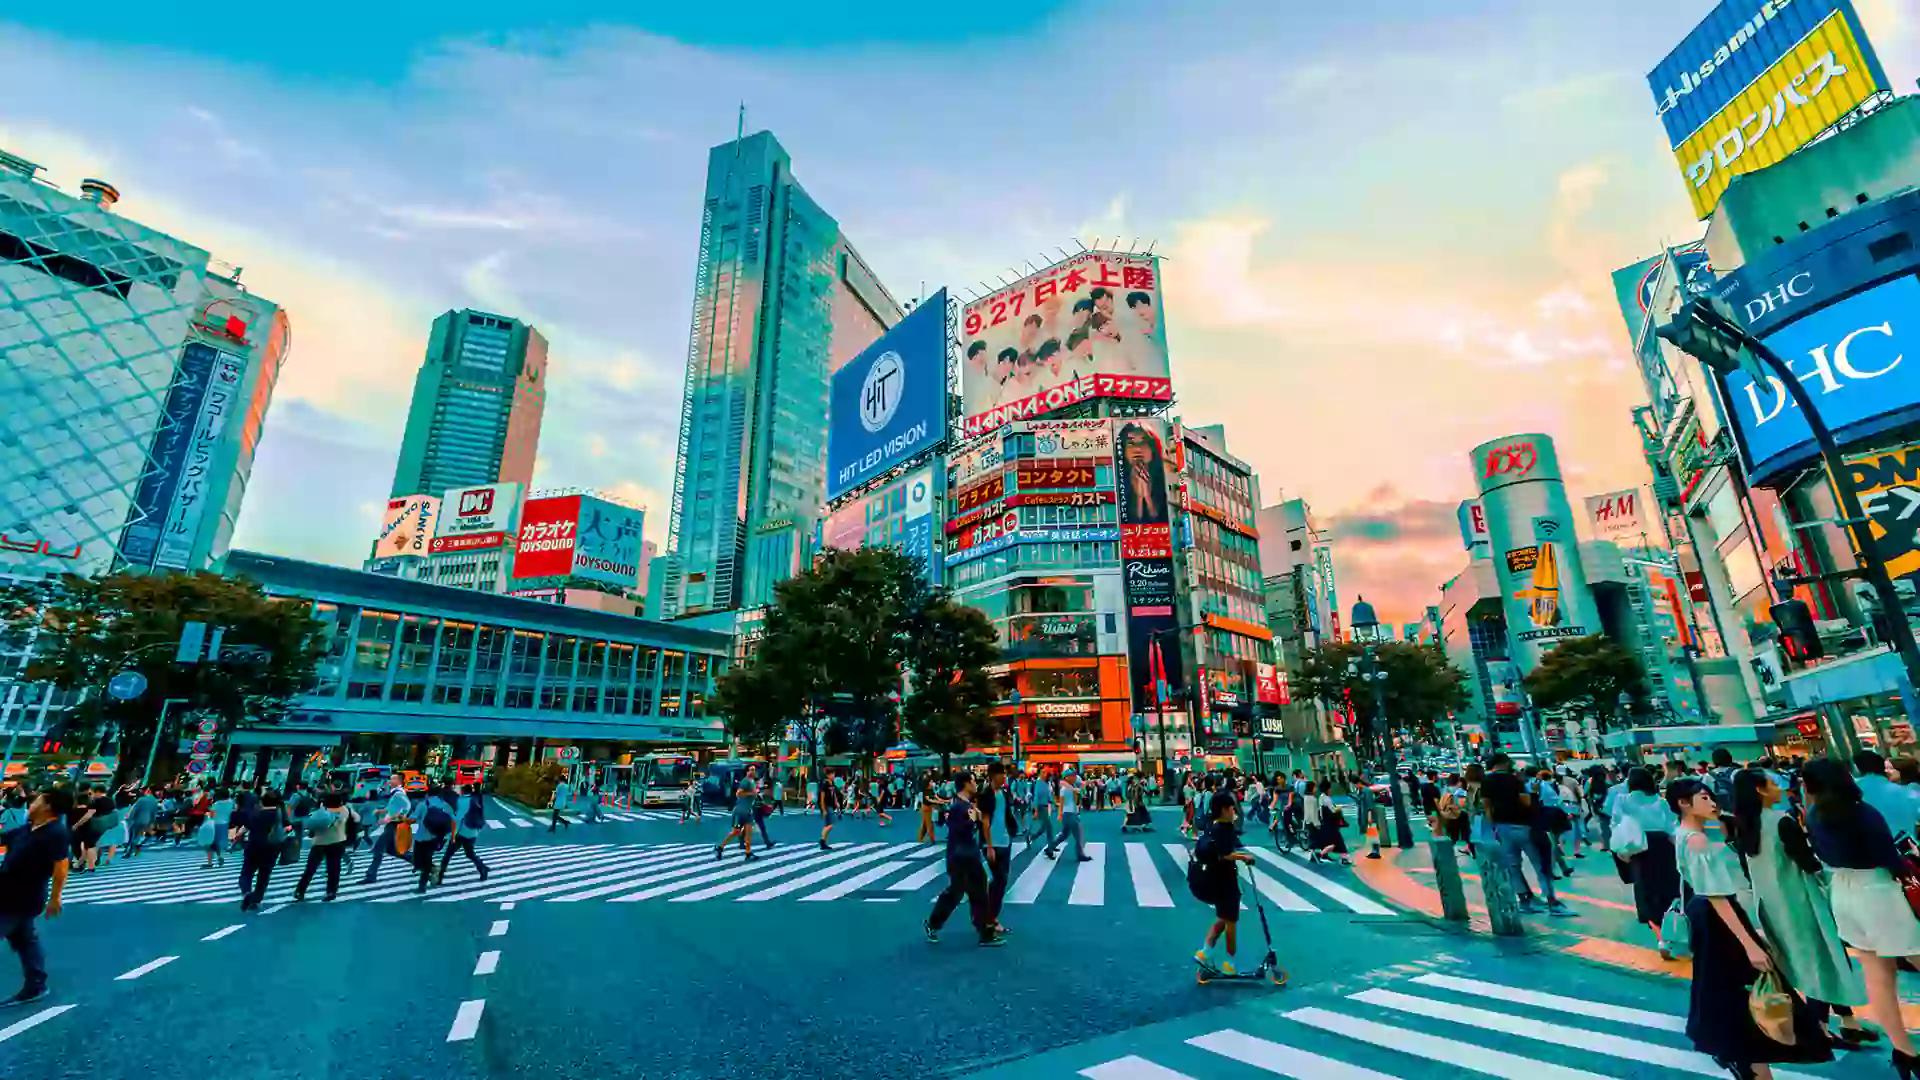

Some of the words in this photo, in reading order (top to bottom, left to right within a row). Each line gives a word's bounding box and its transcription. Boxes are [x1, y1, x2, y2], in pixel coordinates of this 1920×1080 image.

[1686, 50, 1848, 188] サロンパス
[966, 291, 1026, 336] 9.27
[1034, 263, 1156, 308] 日本上陸
[1744, 271, 1814, 324] DHC
[1099, 376, 1168, 395] ワナワン
[1744, 321, 1903, 428] DHC
[839, 463, 857, 484] HIT
[859, 448, 882, 473] LED
[884, 419, 928, 457] VISION
[1018, 469, 1093, 484] コンタクト
[983, 501, 1007, 519] ガスト
[1071, 492, 1107, 505] ガスト
[413, 501, 433, 550] SANKYO
[522, 519, 576, 541] カラオケ
[973, 522, 1001, 544] ガスト
[575, 552, 637, 578] JOYSOUND
[1261, 718, 1283, 733] LUSH
